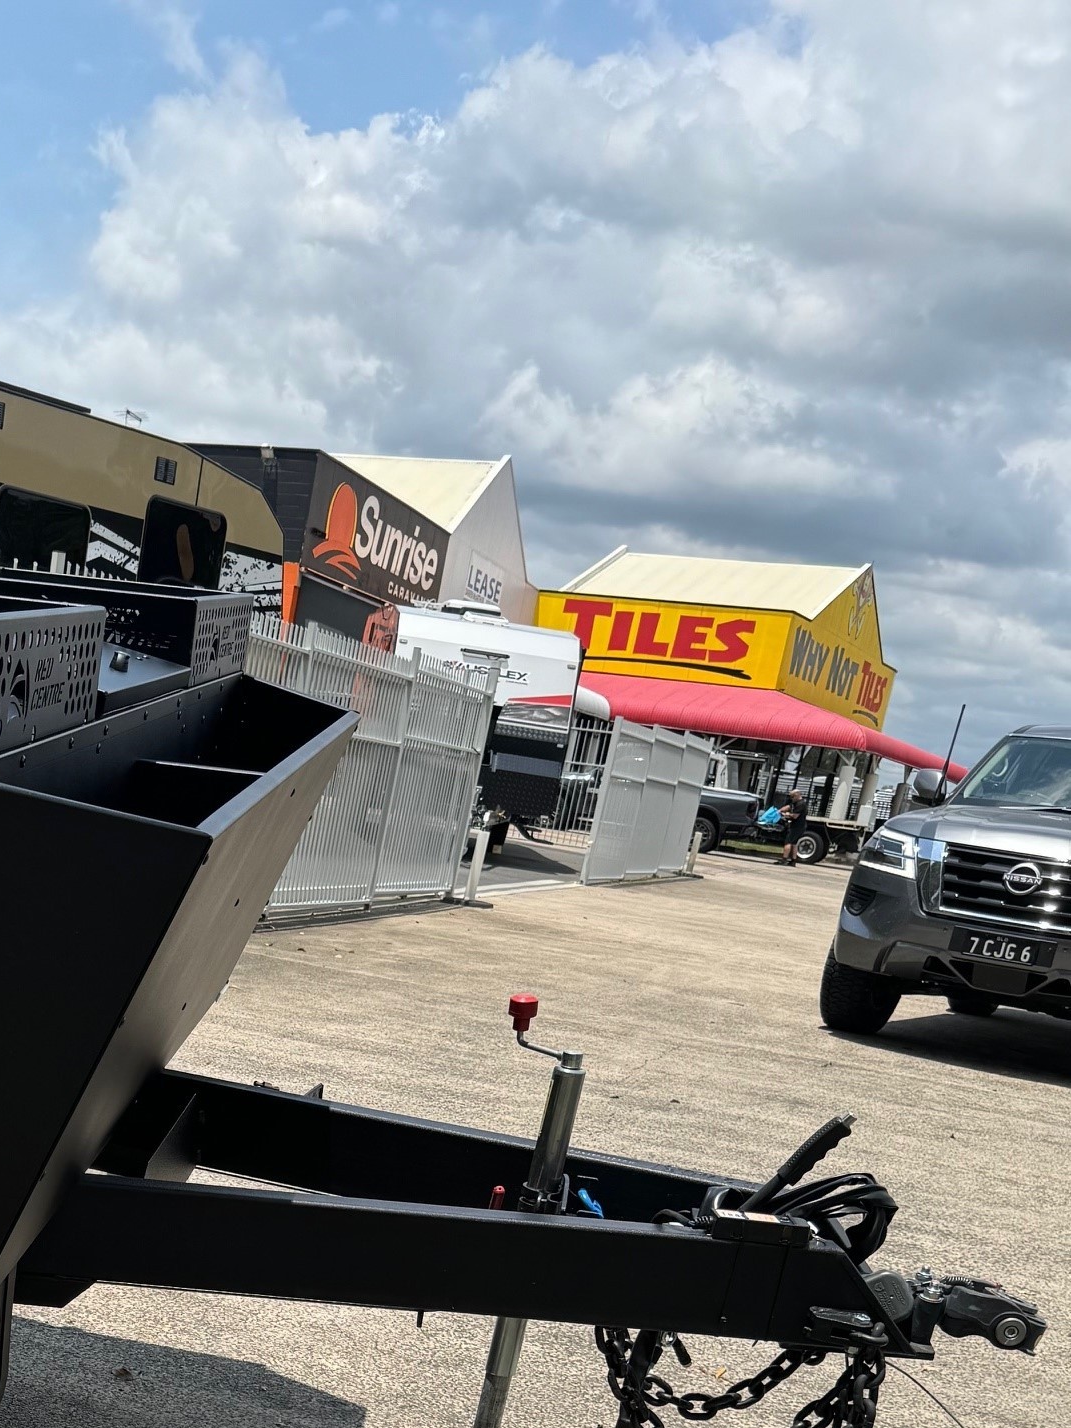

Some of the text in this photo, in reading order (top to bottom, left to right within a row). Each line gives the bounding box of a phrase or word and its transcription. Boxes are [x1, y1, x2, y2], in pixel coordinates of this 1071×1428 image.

[355, 496, 438, 591] Sunrise
[467, 564, 502, 604] LEASE
[563, 598, 757, 664] TILES
[34, 656, 55, 683] RED
[789, 625, 888, 714] WHY NOT TILES
[30, 681, 66, 711] CENTRE
[1003, 873, 1042, 885] NISSAN
